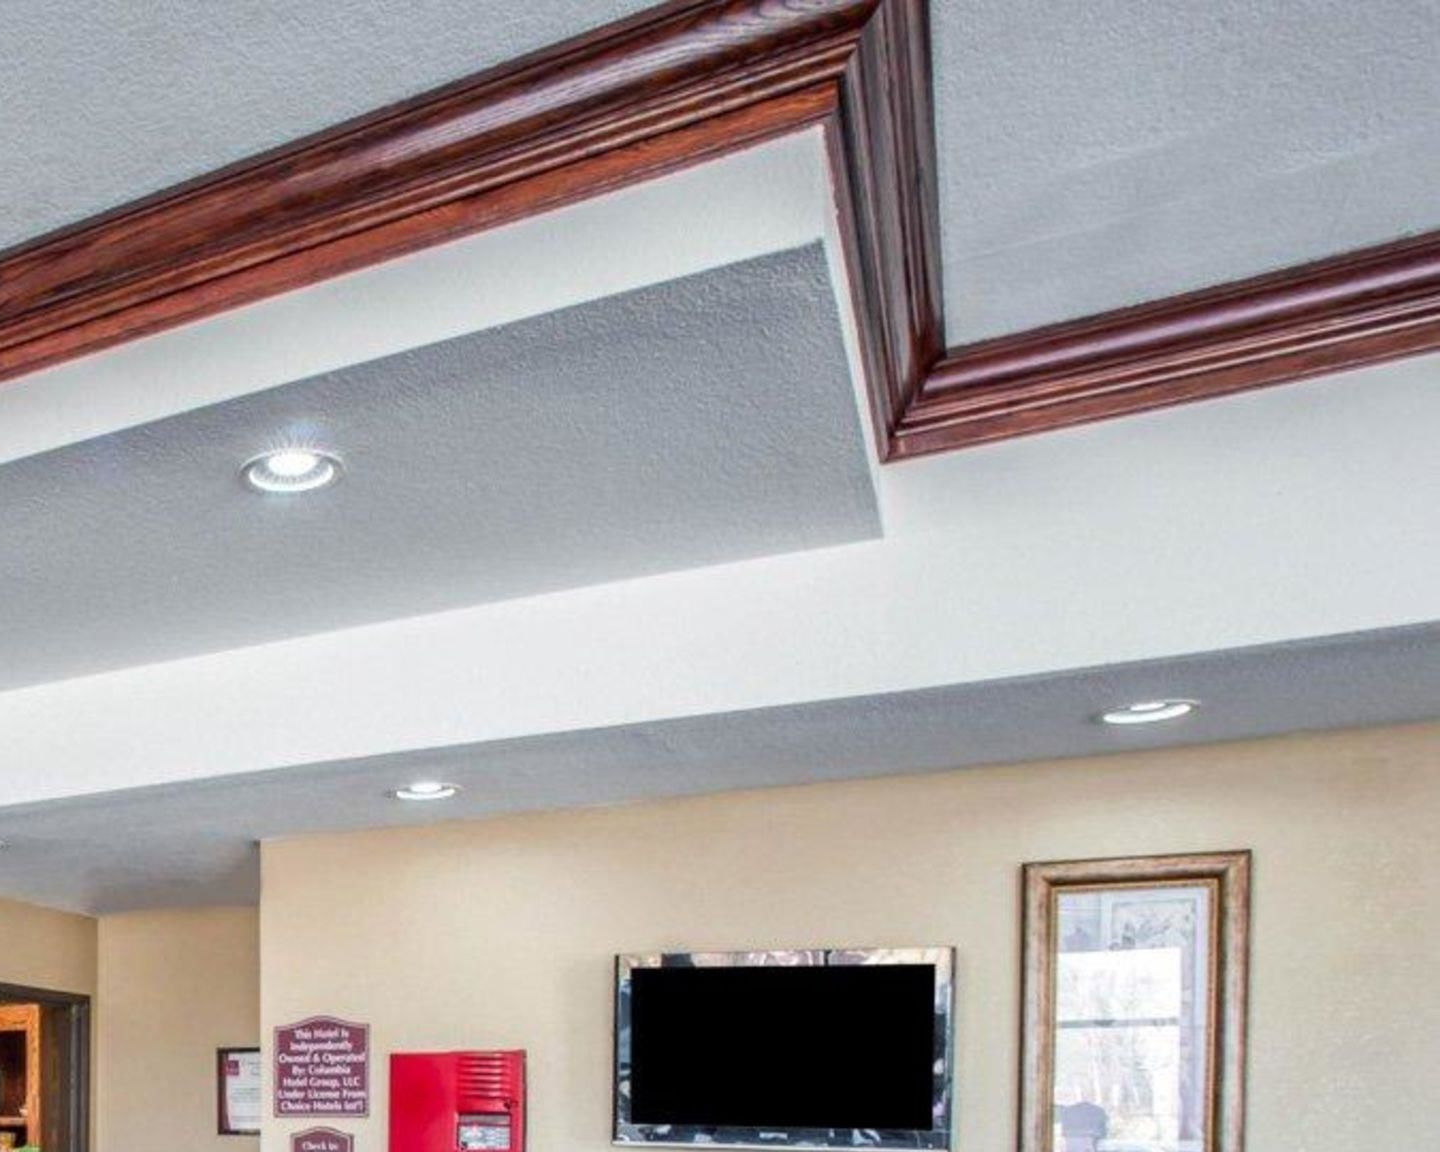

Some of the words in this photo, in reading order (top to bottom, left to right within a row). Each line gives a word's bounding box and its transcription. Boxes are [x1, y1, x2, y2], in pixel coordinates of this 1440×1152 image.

[313, 1028, 339, 1038] Hotel
[290, 1040, 352, 1051] Independently
[279, 1053, 310, 1063] Owned
[313, 1053, 320, 1063] &
[322, 1053, 366, 1064] Operated
[308, 1065, 351, 1075] Columbia
[283, 1077, 307, 1087] Hotel
[343, 1077, 361, 1087] LLC
[278, 1089, 306, 1099] Under
[343, 1089, 367, 1099] From
[280, 1100, 311, 1111] Choice
[302, 1141, 327, 1151] Check
